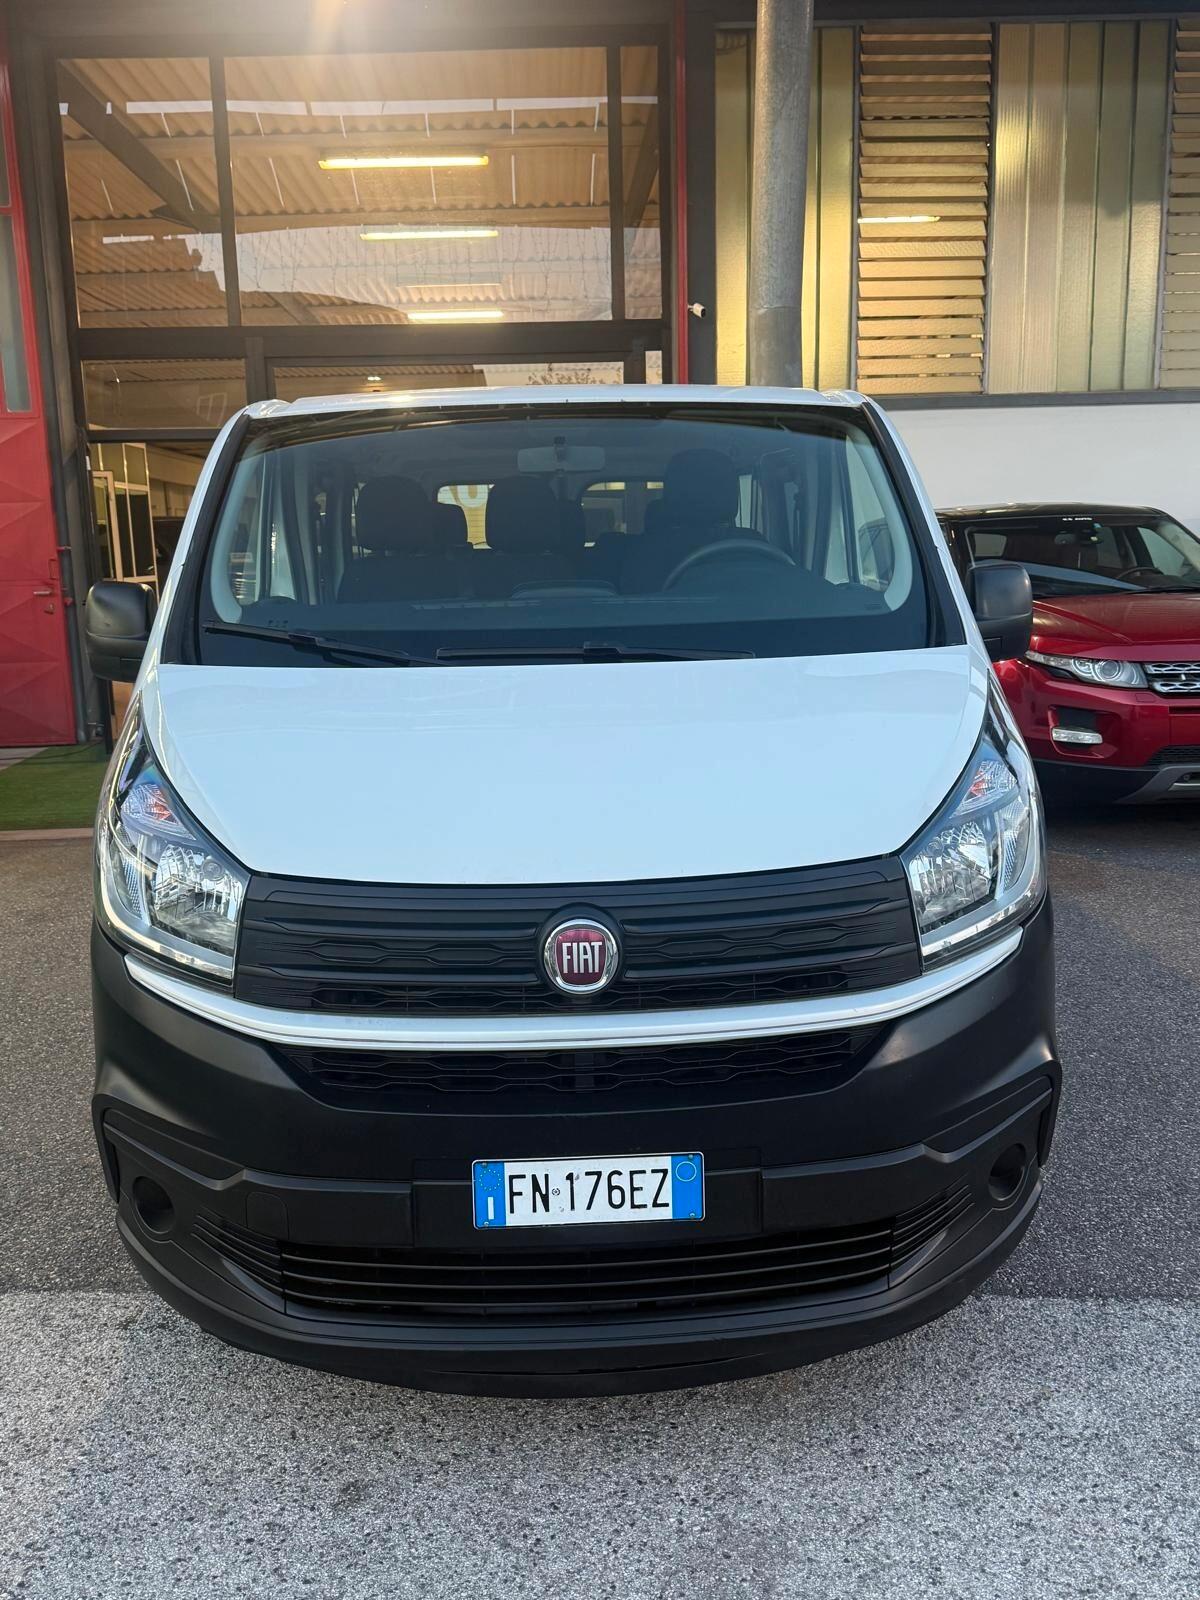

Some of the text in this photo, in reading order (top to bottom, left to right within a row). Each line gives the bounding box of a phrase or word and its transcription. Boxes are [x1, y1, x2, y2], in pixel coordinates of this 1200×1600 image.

[562, 941, 602, 974] FIAT
[508, 1168, 670, 1214] FN 176EZ
[487, 1196, 495, 1220] I
